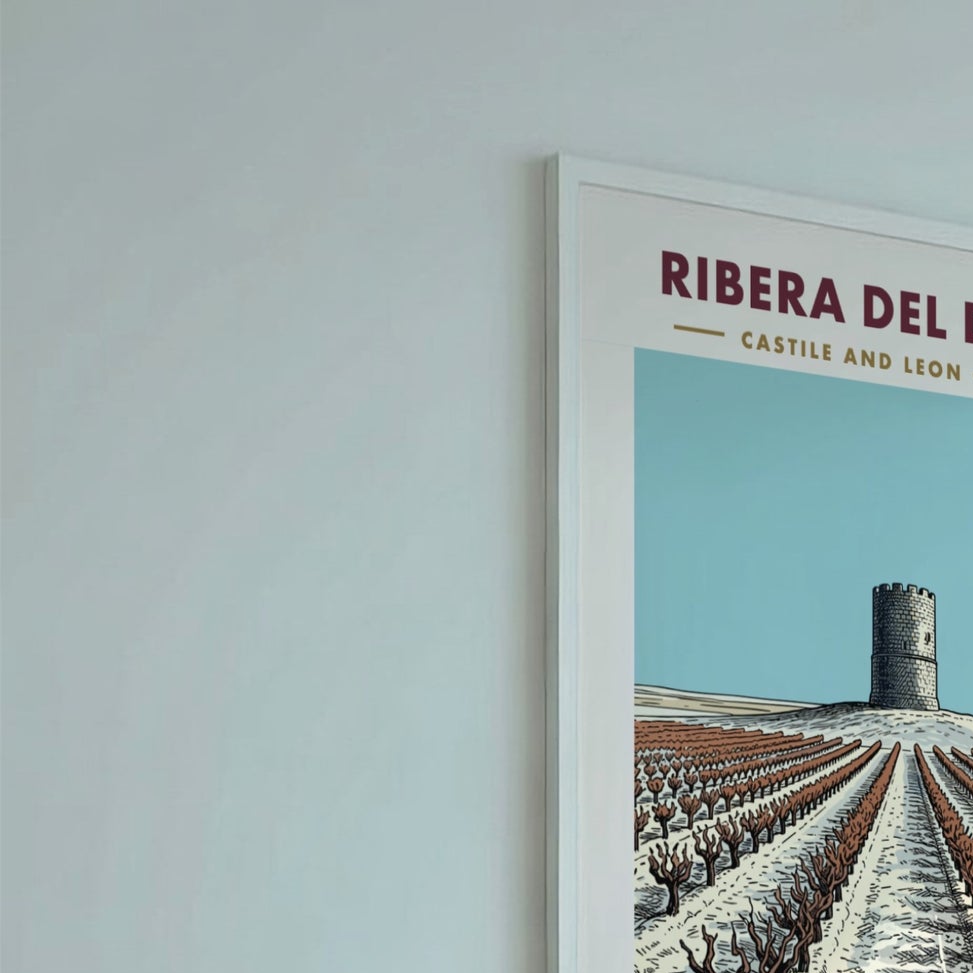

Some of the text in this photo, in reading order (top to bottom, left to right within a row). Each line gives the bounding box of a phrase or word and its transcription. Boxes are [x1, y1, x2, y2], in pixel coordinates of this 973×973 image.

[662, 251, 845, 323] RIBERA
[864, 285, 946, 339] DEL
[741, 331, 831, 361] CASTILE
[844, 348, 891, 369] AND
[905, 356, 960, 380] LEON
